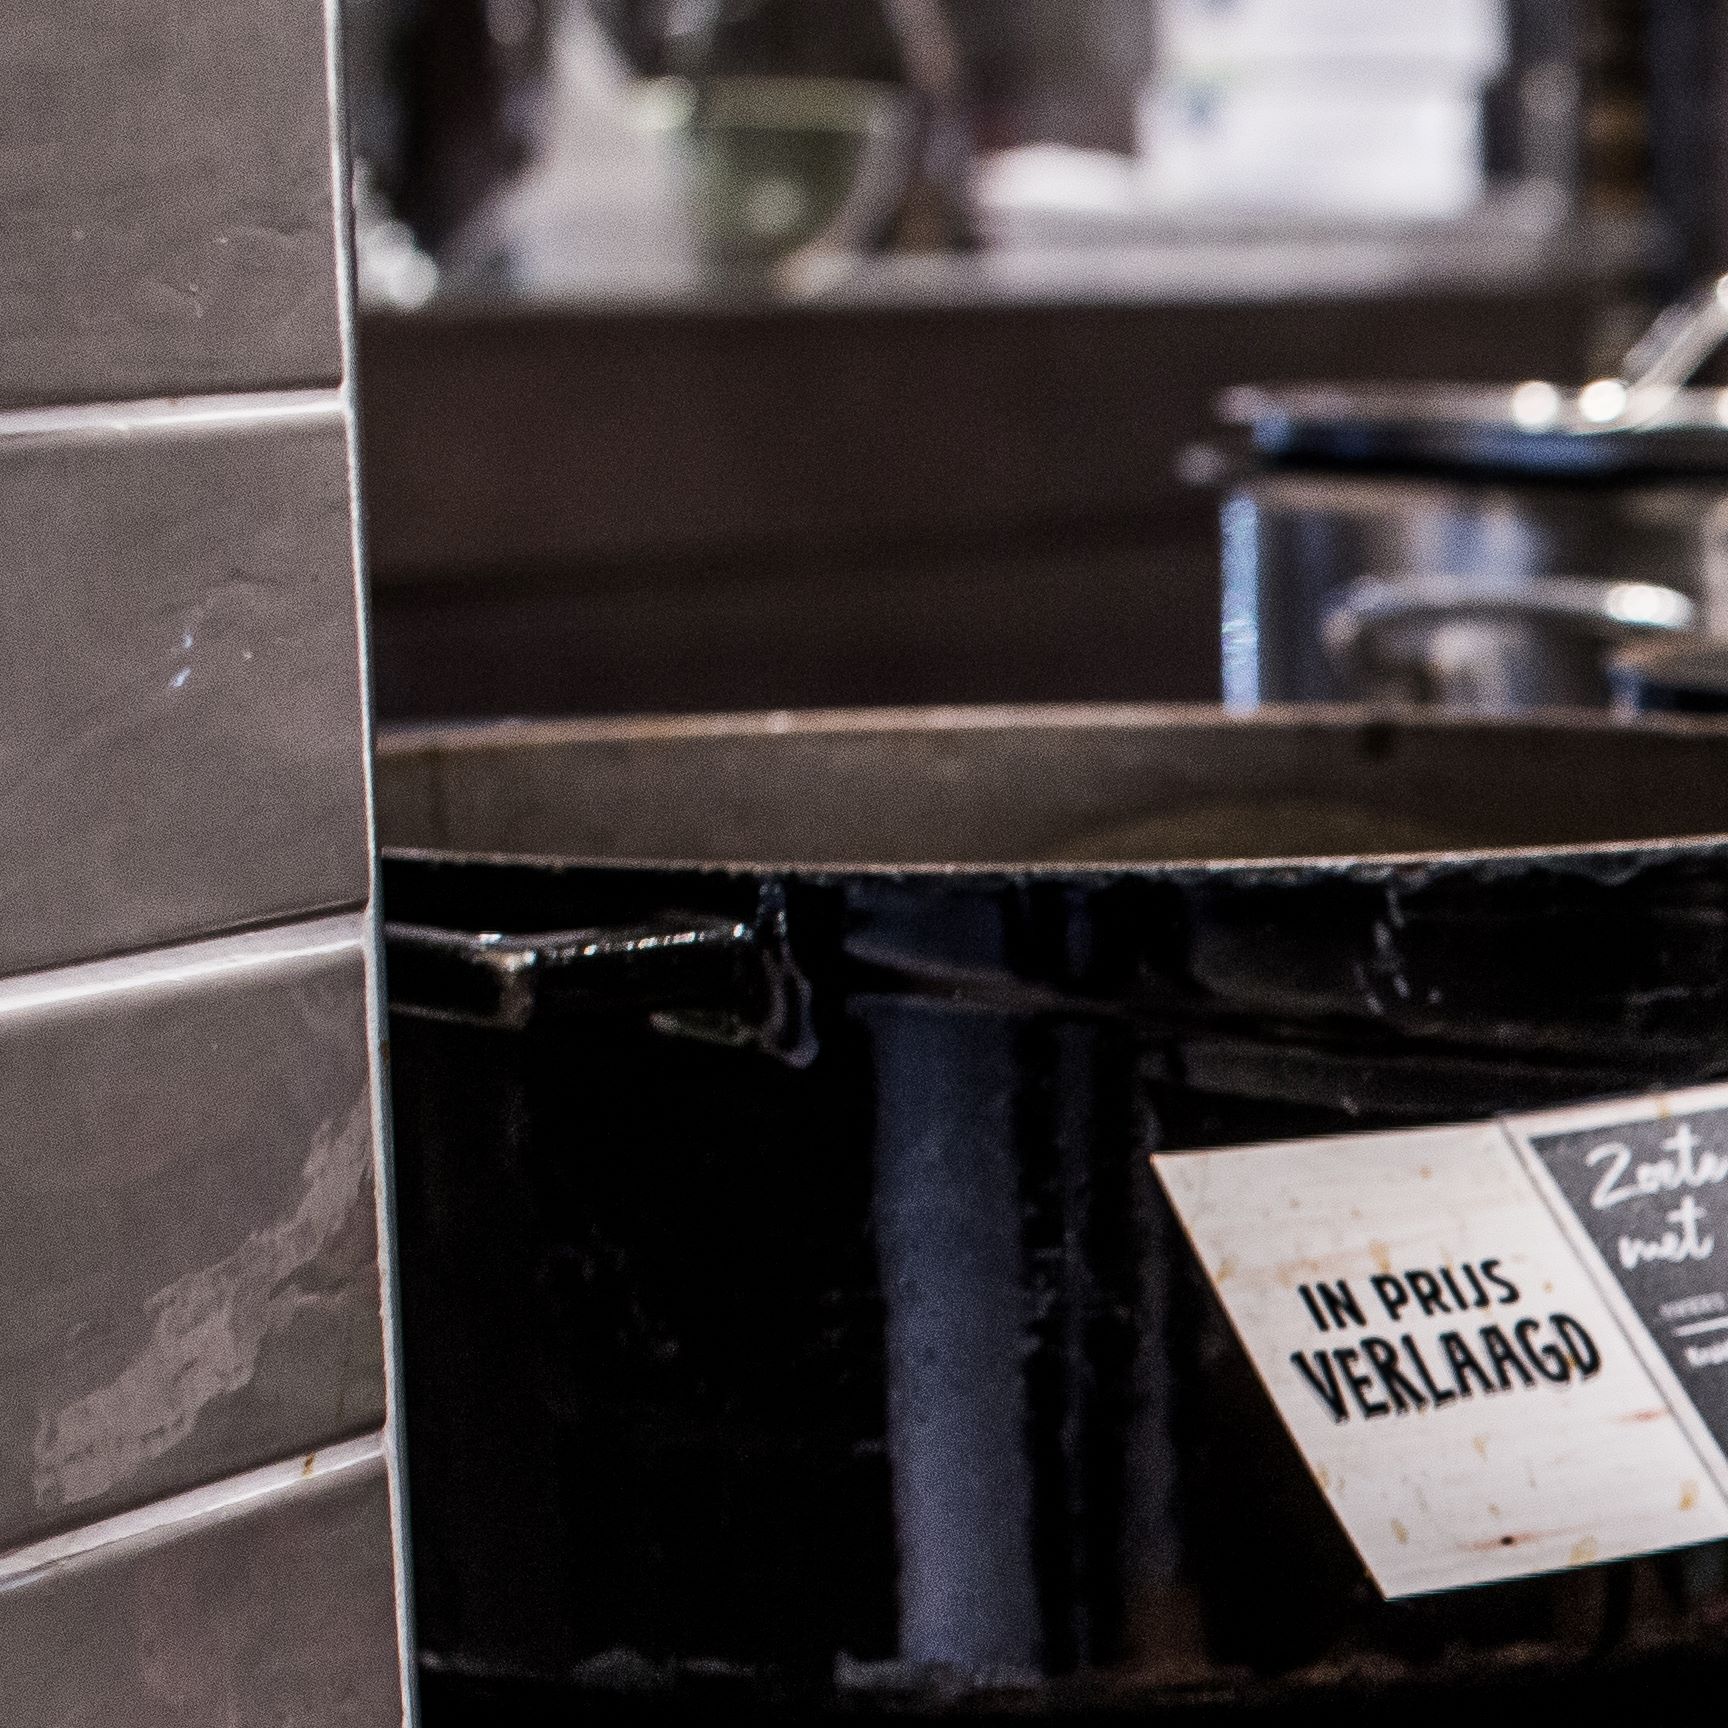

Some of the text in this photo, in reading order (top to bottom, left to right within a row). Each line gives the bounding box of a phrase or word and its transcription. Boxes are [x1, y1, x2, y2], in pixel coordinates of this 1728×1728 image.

[1618, 1196, 1714, 1269] met
[1299, 1258, 1520, 1332] IN PRIJS
[1290, 1312, 1602, 1424] VERLAAGD
